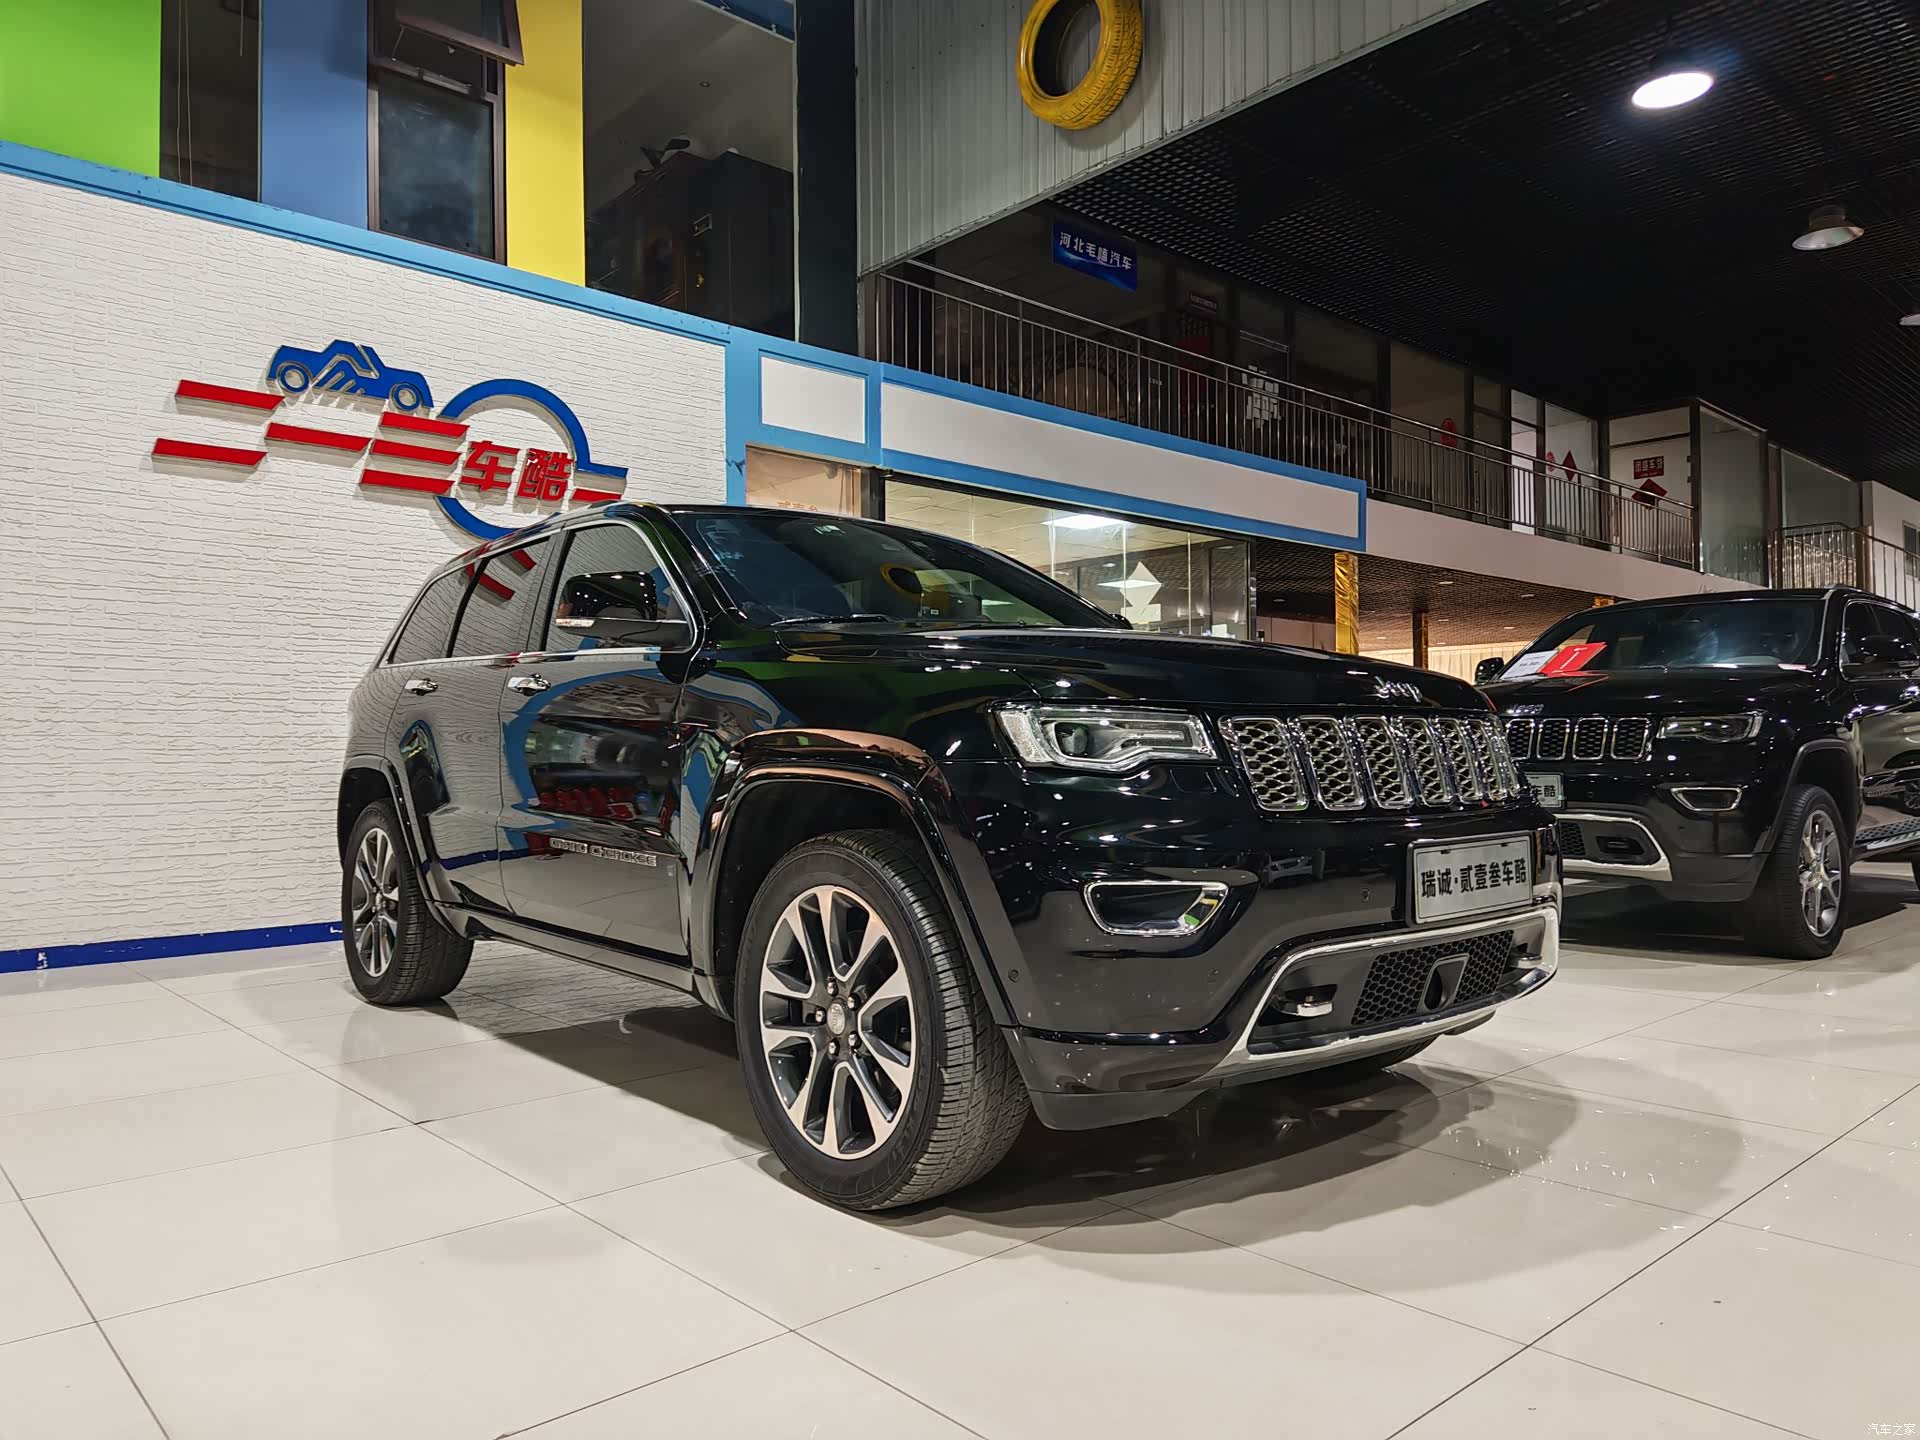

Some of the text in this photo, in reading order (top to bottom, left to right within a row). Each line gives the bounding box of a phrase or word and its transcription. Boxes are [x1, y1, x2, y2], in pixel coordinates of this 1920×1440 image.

[1374, 675, 1423, 703] Jeep
[549, 838, 657, 867] GRAND CHEROKEE
